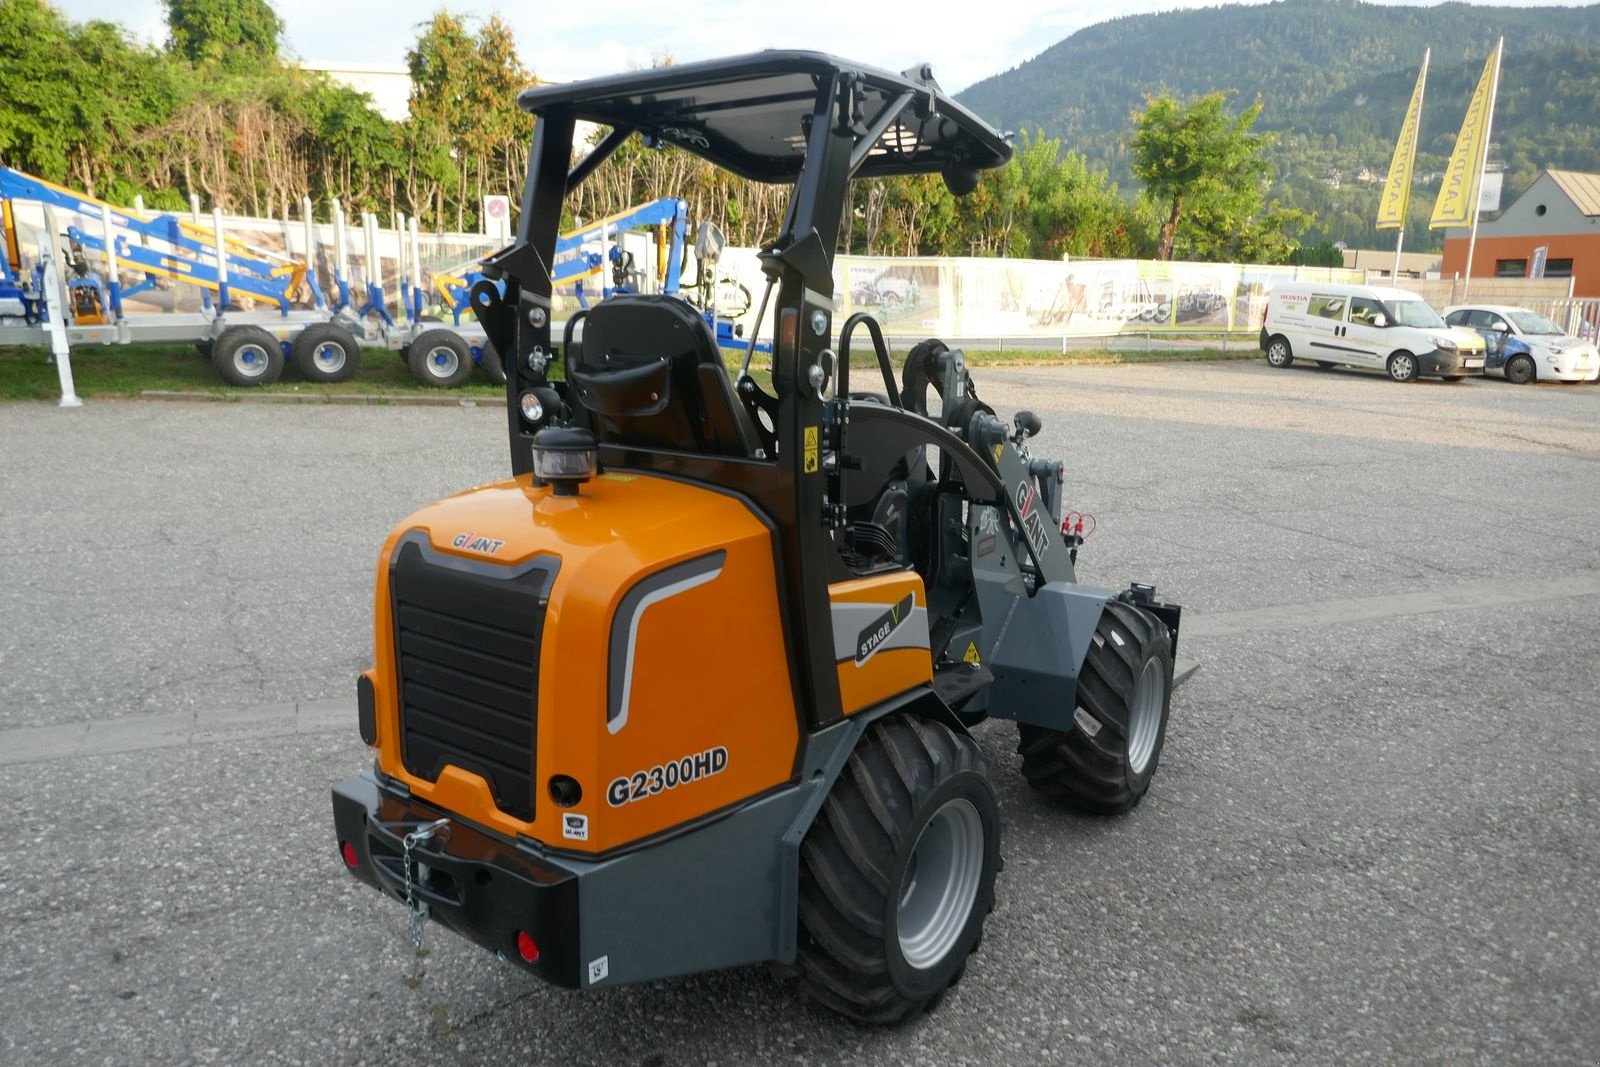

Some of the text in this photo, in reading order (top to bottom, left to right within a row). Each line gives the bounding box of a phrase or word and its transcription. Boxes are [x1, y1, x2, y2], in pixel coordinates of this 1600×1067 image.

[1280, 294, 1308, 302] HONDA
[861, 620, 891, 656] STAGE
[607, 745, 729, 808] G2300HD
